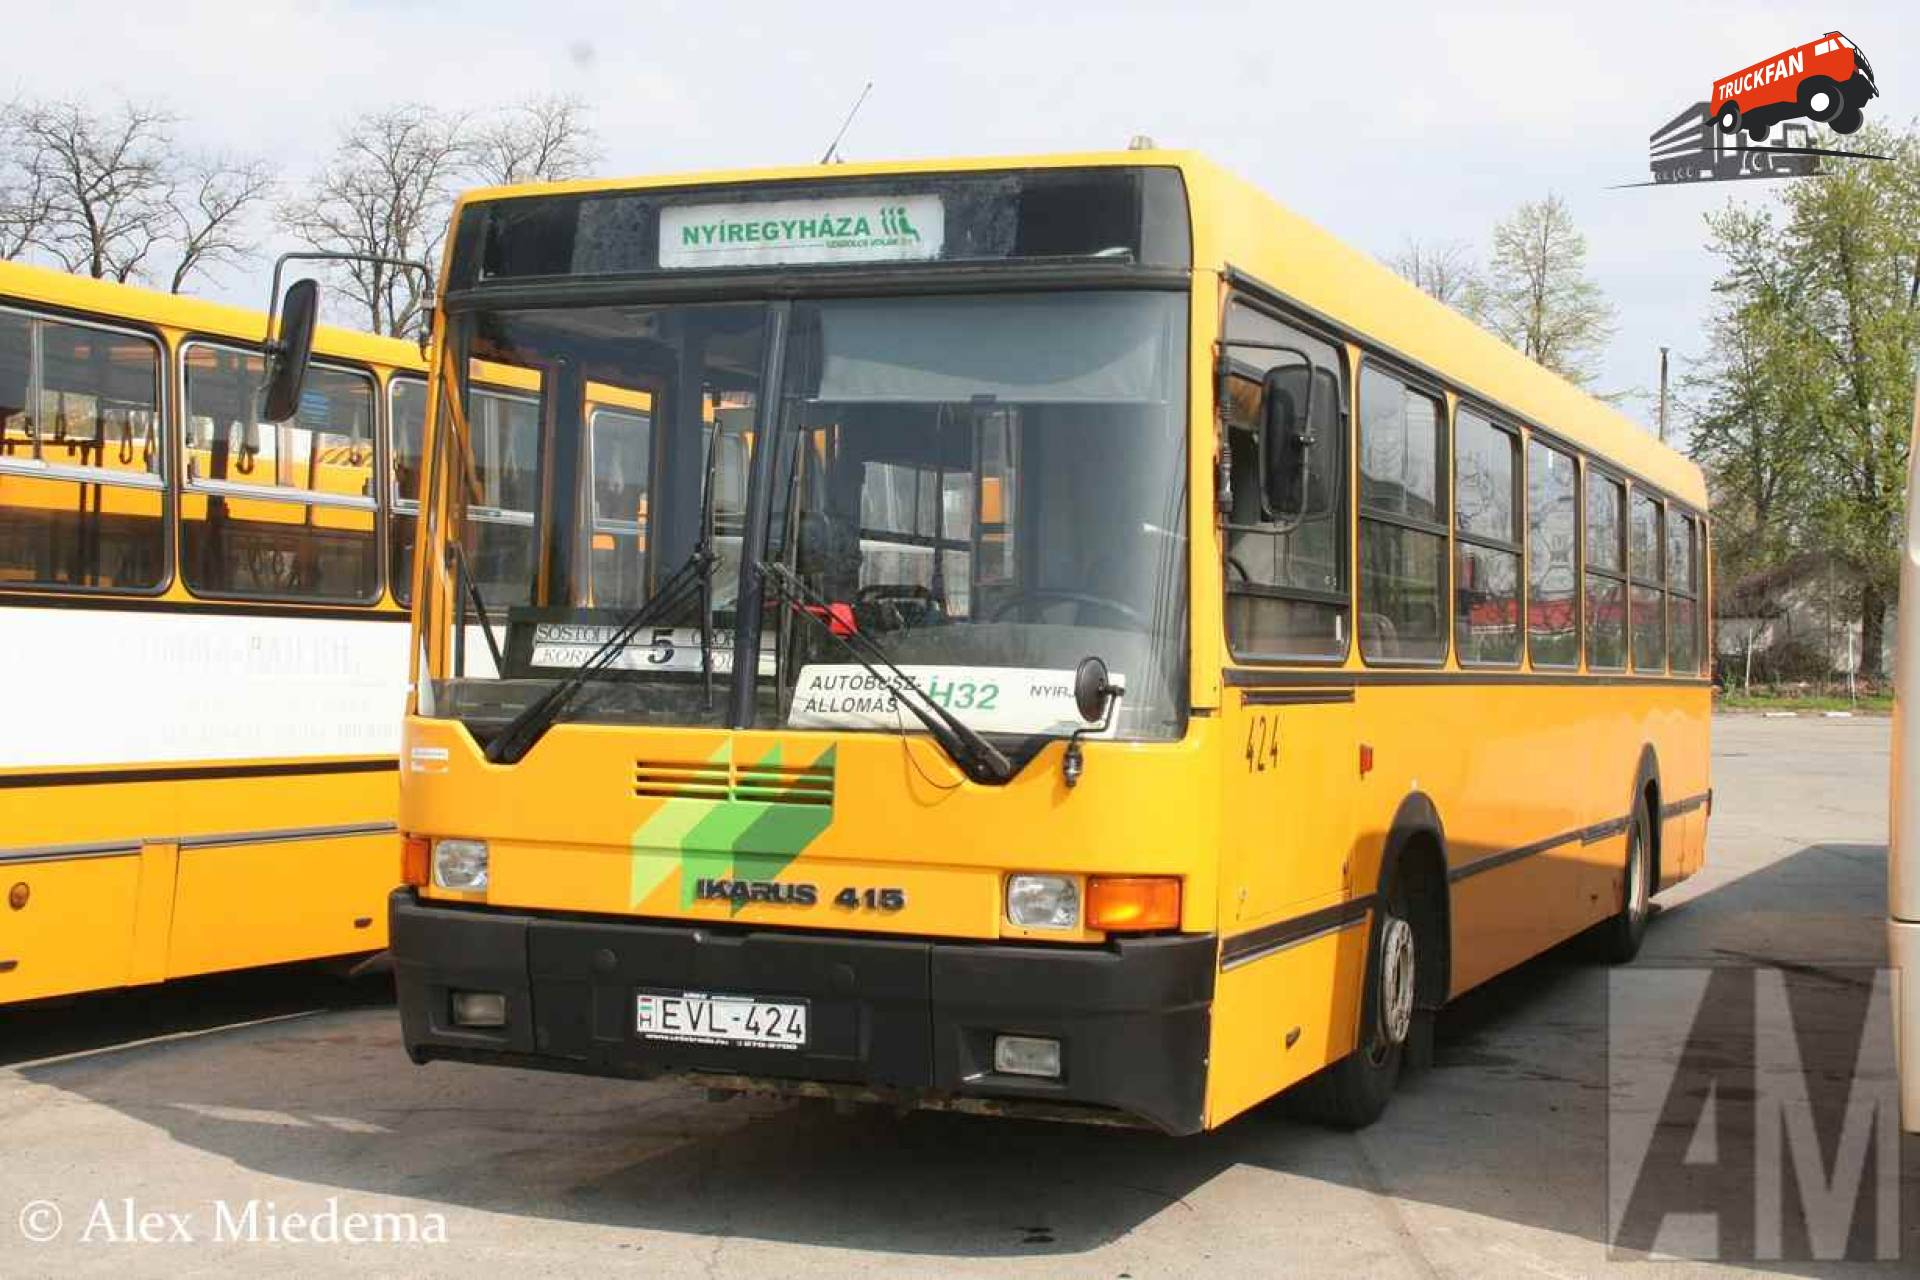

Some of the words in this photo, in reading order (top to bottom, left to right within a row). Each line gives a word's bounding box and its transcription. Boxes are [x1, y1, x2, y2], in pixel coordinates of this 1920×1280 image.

[682, 213, 871, 245] NYÍREGYHÁZA
[647, 628, 674, 664] 5
[1245, 714, 1278, 773] 424
[696, 878, 817, 906] IKARUS
[834, 887, 904, 911] 415
[662, 999, 802, 1039] EVL-424
